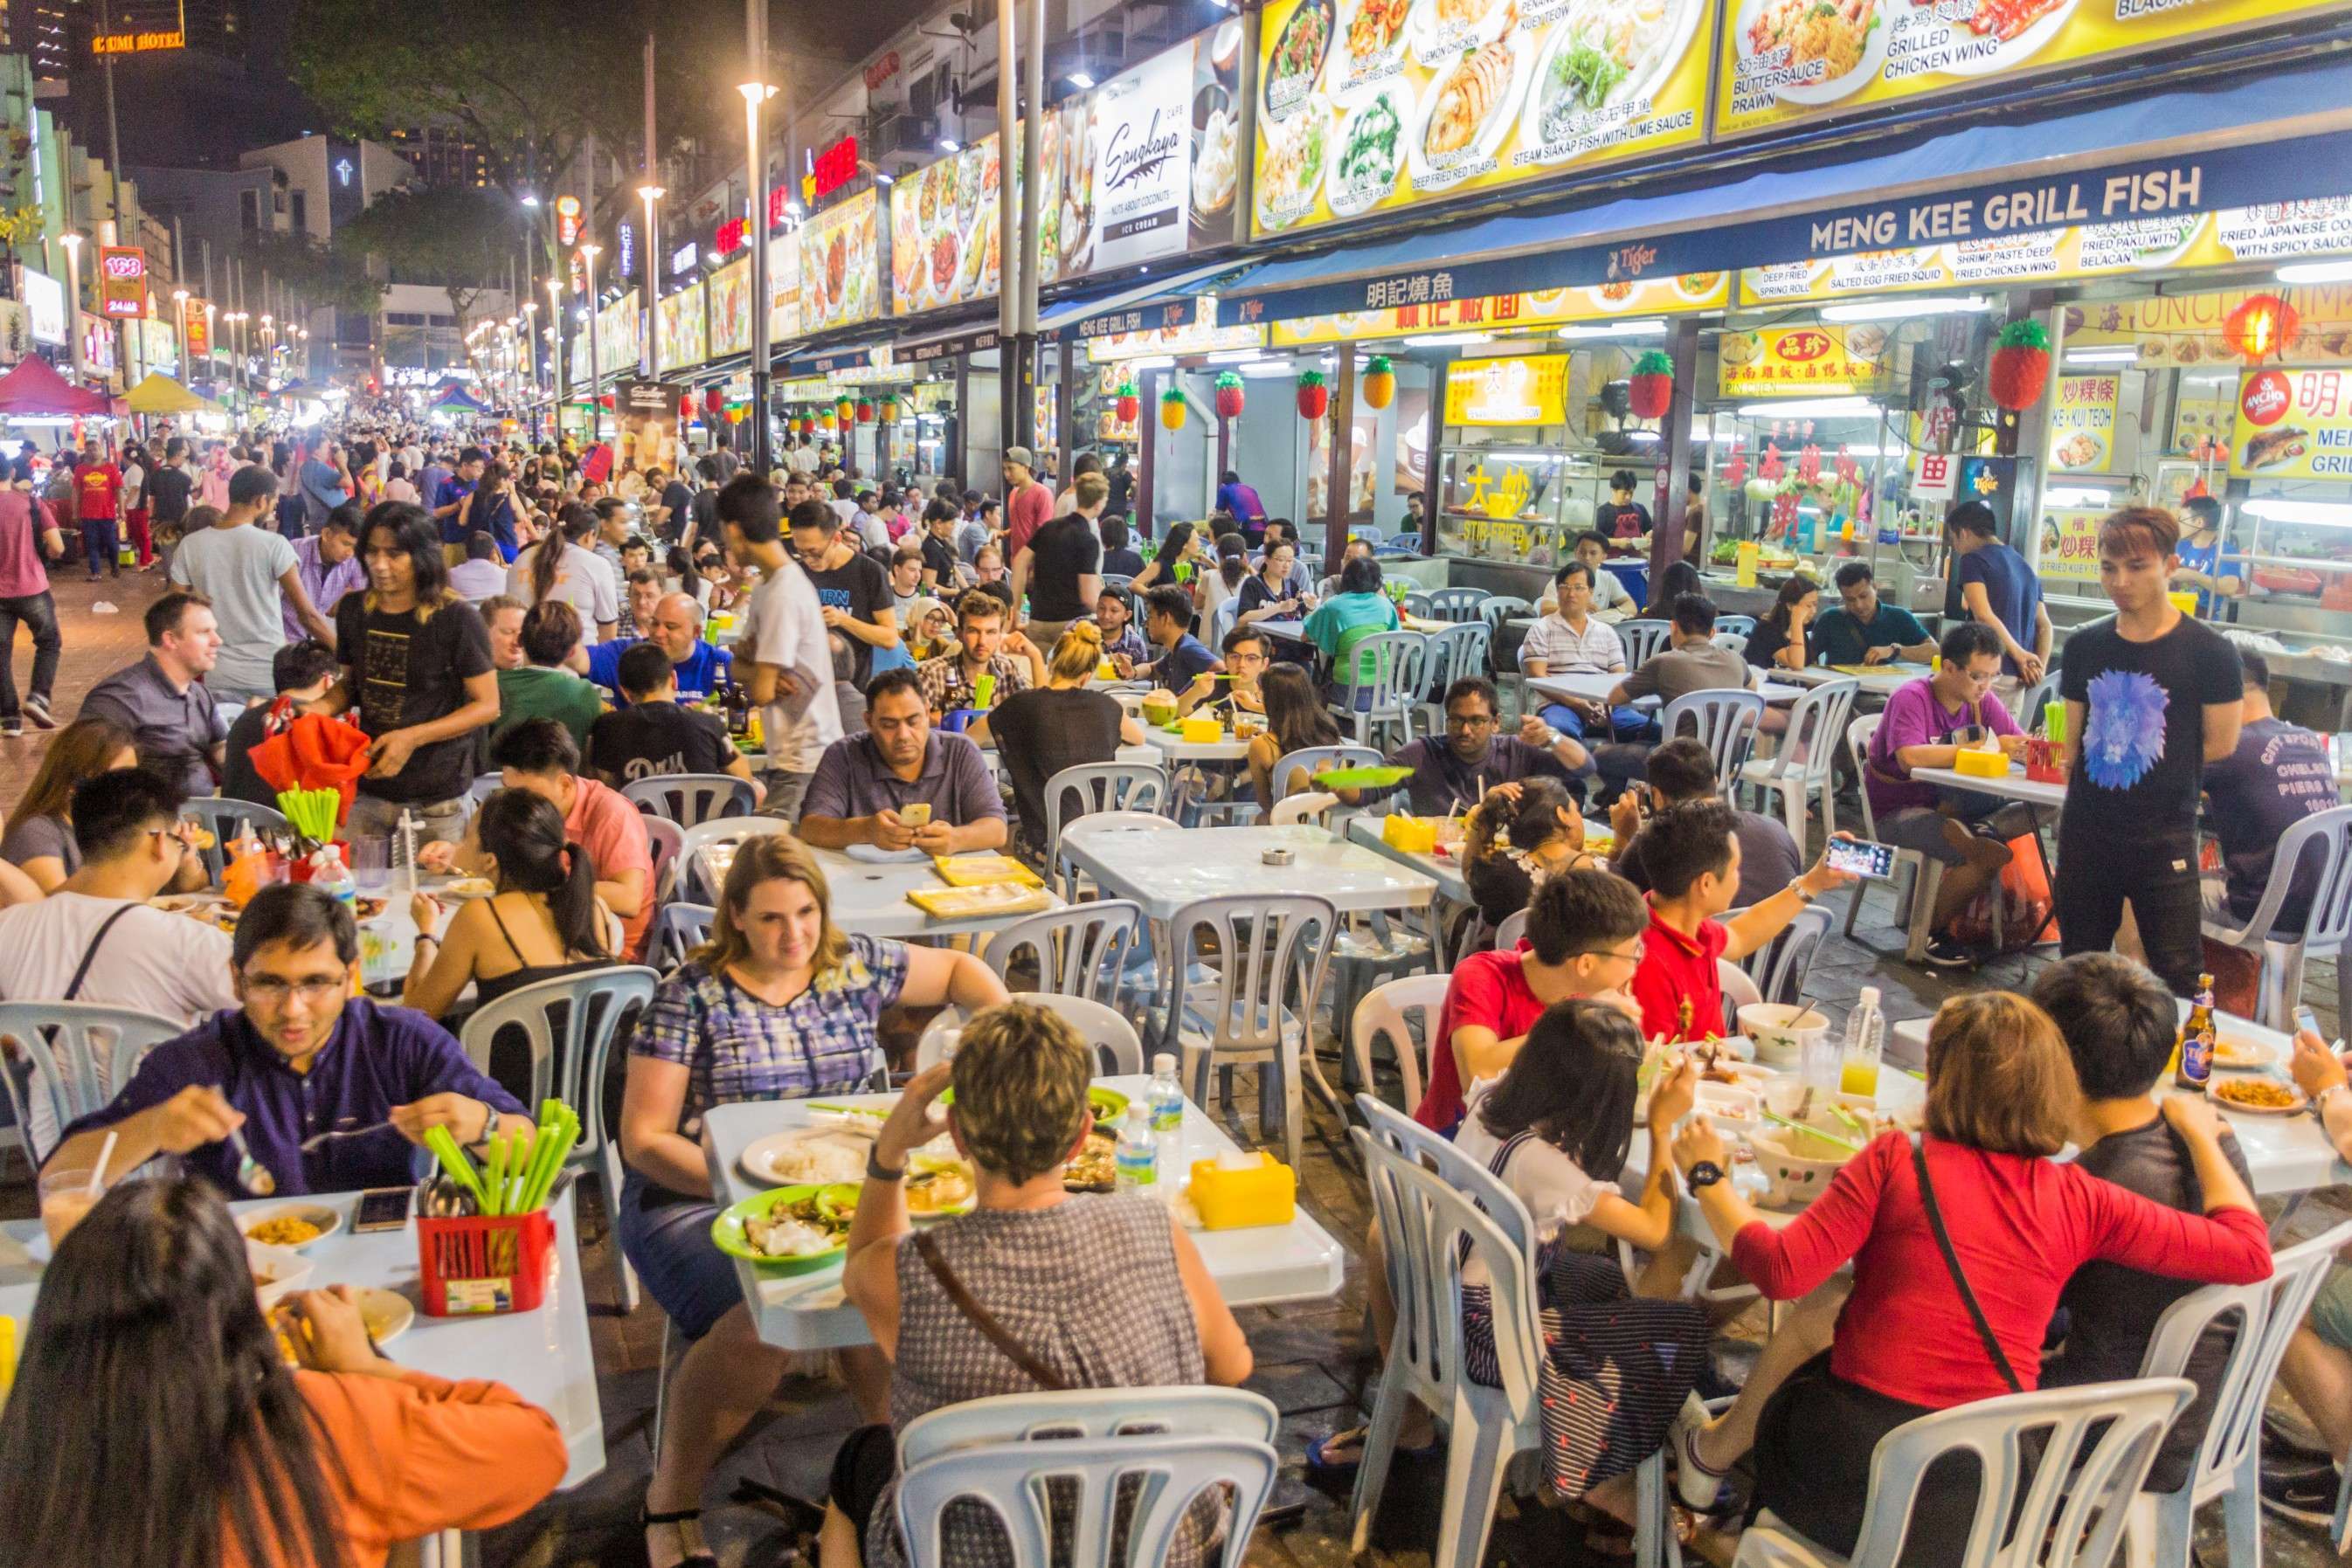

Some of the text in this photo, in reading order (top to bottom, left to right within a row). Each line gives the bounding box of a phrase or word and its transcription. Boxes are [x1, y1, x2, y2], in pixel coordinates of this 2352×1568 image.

[1545, 5, 1571, 23] TEOW
[136, 31, 183, 51] HOTEL
[1422, 34, 1479, 64] LEMON CHICKEN
[1887, 28, 1949, 58] GRILLED
[1885, 38, 1998, 79] CHICKEN WING
[1365, 70, 1383, 83] FRIED
[1384, 61, 1405, 77] SQUID
[1733, 60, 1823, 96] BUTTERSAUCE
[1732, 92, 1775, 114] PRAWN
[1105, 107, 1179, 190] Sangkaya
[1512, 111, 1693, 166] STEAM SIAKAP FISH WITH LIME SAUCE
[1412, 159, 1498, 189] DEEP FRIED RED TILAPIA
[1124, 198, 1140, 213] ABOUT
[1332, 194, 1349, 207] FRIED
[1350, 187, 1374, 204] BUTTER
[1811, 211, 1896, 252] MENG
[1909, 200, 1972, 241] KEE
[1984, 183, 2088, 231] GRILL
[2102, 167, 2201, 216] FISH
[1122, 217, 1159, 234] ICE CREAM
[2220, 228, 2256, 241] FRIED
[2259, 220, 2327, 238] JAPANESE
[2082, 232, 2178, 252] FRIED PAKU WITH
[2236, 243, 2267, 257] WITH
[2272, 238, 2308, 253] SPICY
[1621, 244, 1657, 275] Tiger
[1956, 246, 2052, 265] SHRIMP PASTE DEEP
[2080, 253, 2132, 267] BELACAN
[1763, 269, 1808, 284] DEEP FRIED
[1830, 269, 1940, 289] SALTED EGG FRIED SQUID
[1955, 261, 2056, 279] FRIED CHICKEN WING
[1366, 273, 1453, 307] 明記燒魚
[1760, 283, 1809, 297] SPRING ROLL
[1079, 320, 1096, 337] MENG
[1096, 317, 1110, 335] KEE
[1110, 314, 1126, 333] GRILL
[1126, 312, 1142, 329] FISH
[2298, 371, 2352, 418] 明
[2071, 409, 2086, 426] KUI
[2089, 408, 2112, 426] TEOH
[2317, 429, 2352, 446] ME
[1973, 474, 1998, 495] Tiger
